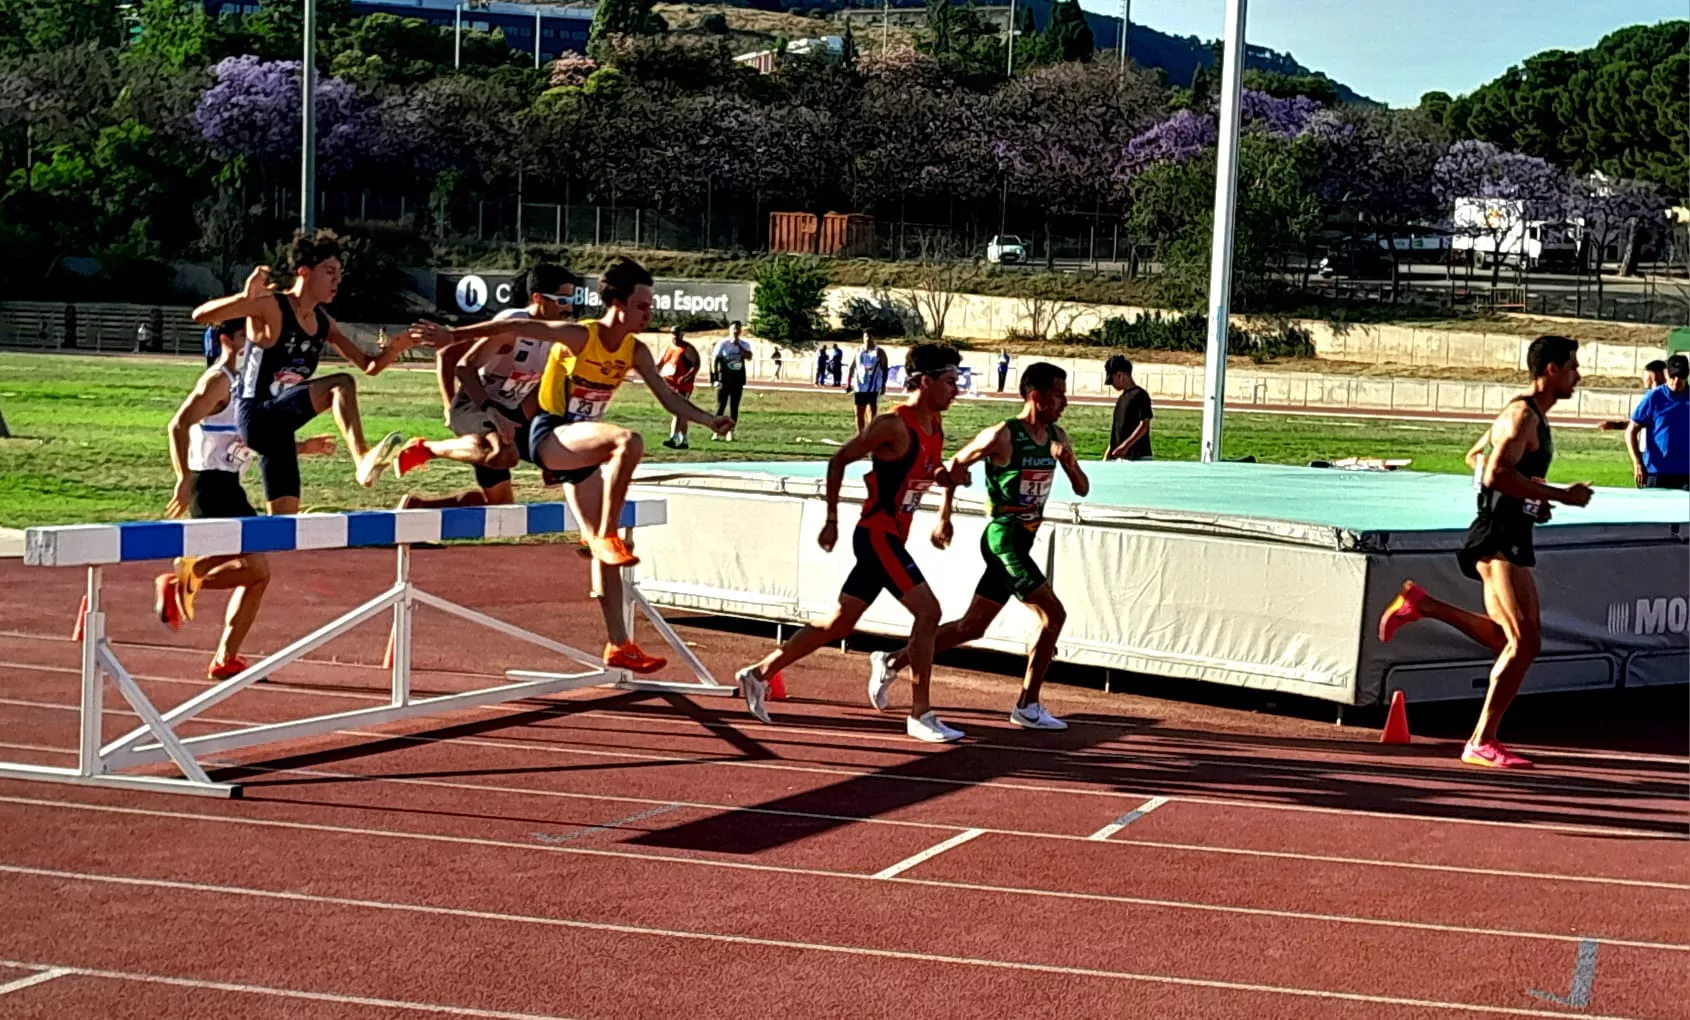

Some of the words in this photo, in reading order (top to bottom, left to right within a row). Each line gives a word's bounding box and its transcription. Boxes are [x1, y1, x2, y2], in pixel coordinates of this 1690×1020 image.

[674, 289, 729, 315] Esport
[1028, 481, 1041, 495] 21
[1635, 597, 1690, 635] MO
